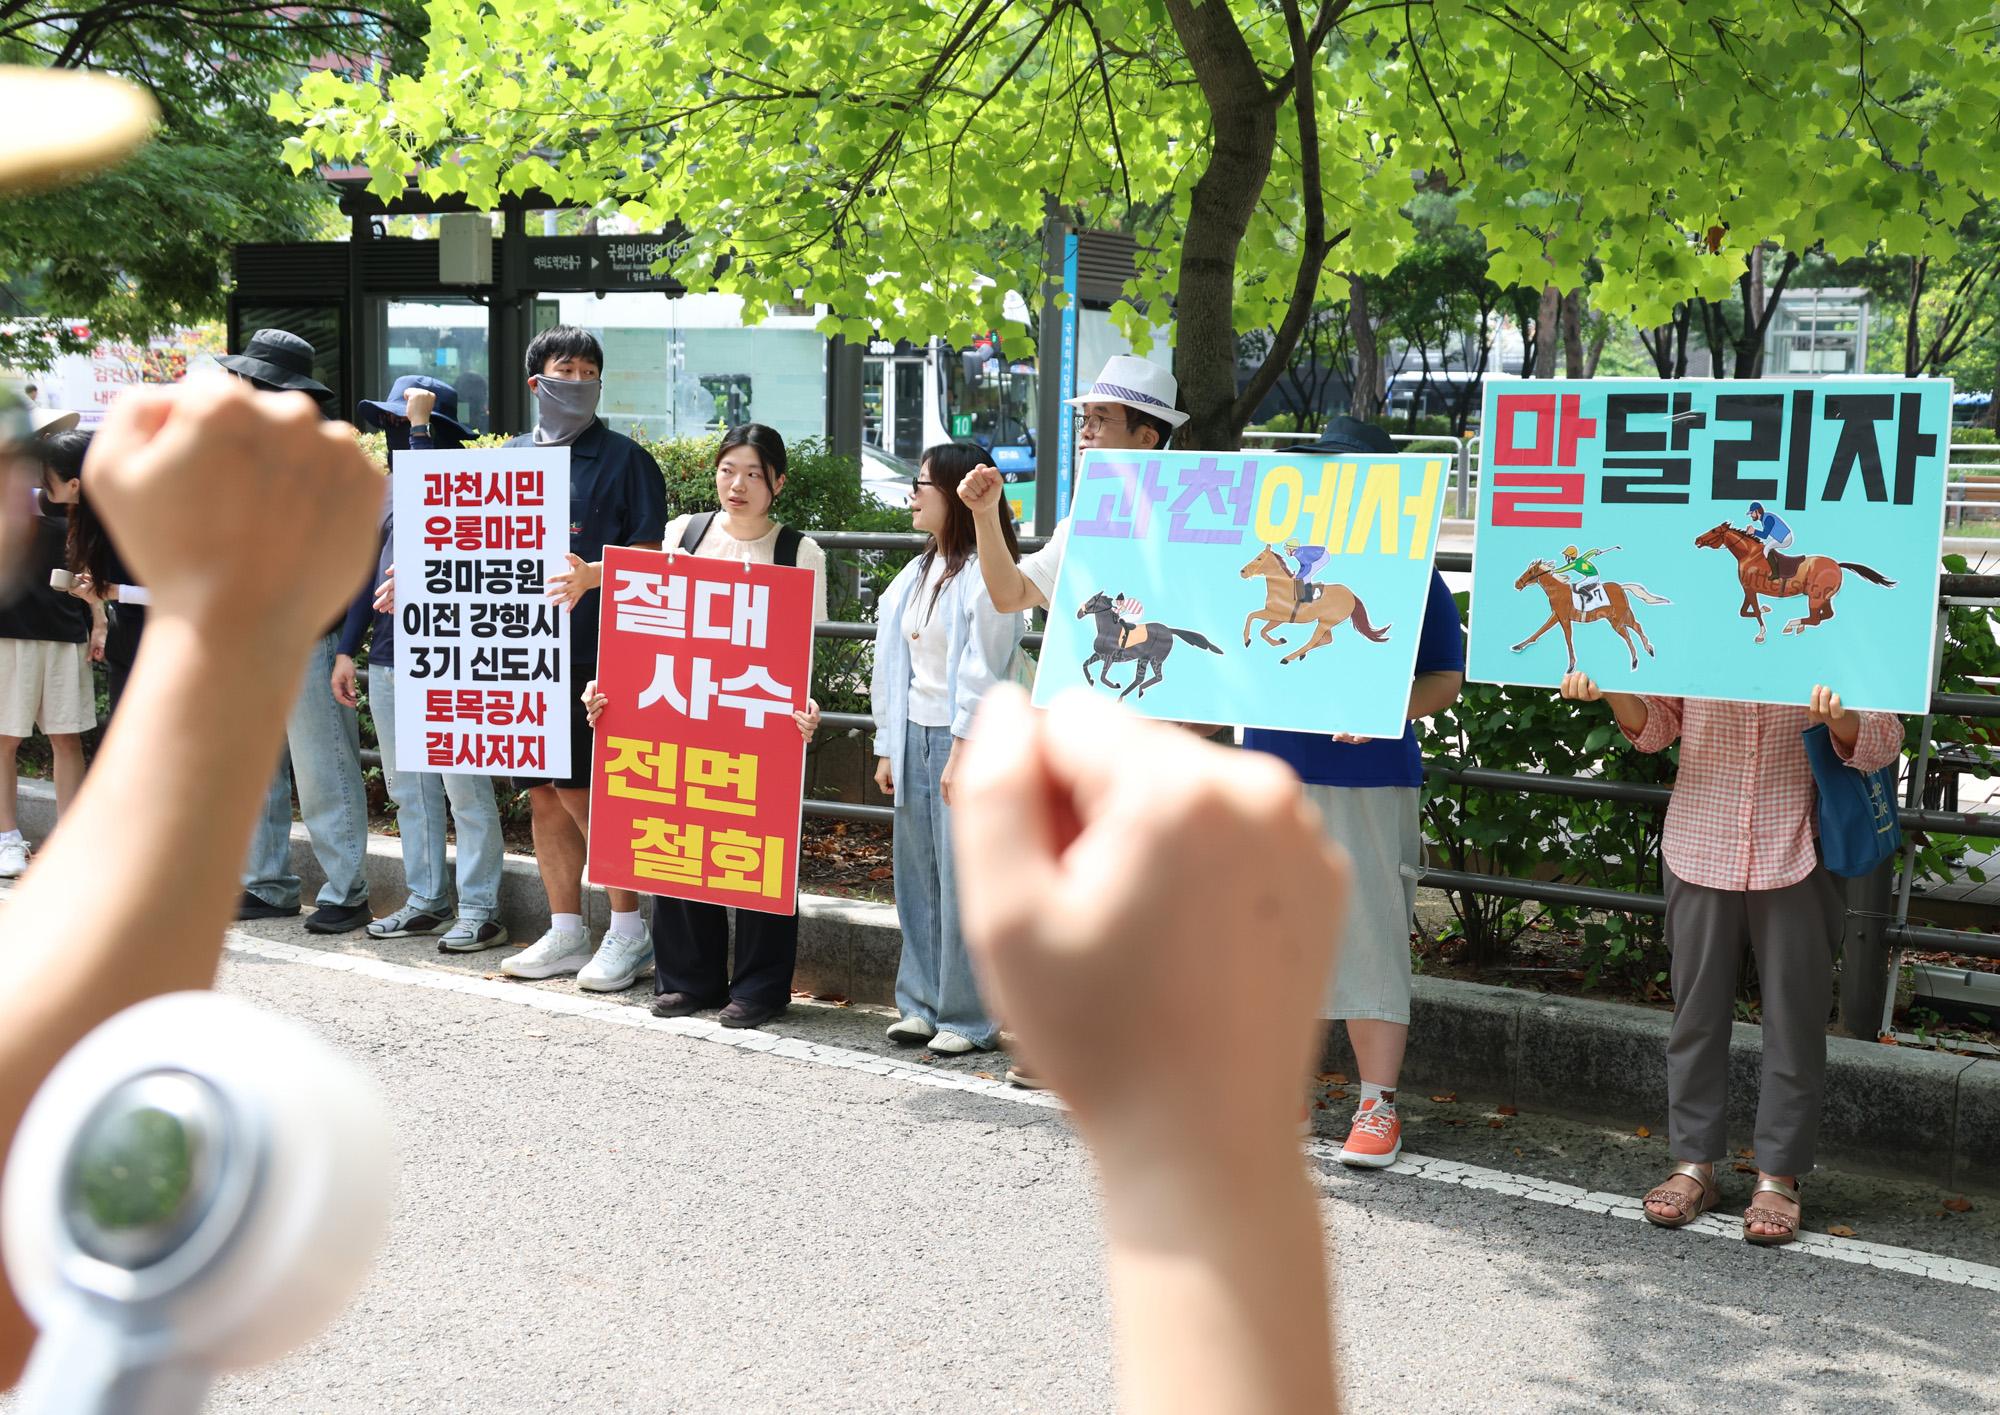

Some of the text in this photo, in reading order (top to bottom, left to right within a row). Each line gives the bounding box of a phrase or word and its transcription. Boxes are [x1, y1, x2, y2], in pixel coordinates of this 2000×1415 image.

[533, 255, 581, 271] 여의도역3번출구
[955, 418, 969, 434] 10
[1491, 389, 1938, 529] 말달리자
[423, 471, 544, 507] 과천시민
[1073, 457, 1443, 560] 과천에서
[424, 515, 546, 551] 우롱마라
[424, 559, 545, 594] 경마공원
[403, 602, 560, 639] 이전 강행시
[613, 569, 770, 650] 절대
[409, 646, 561, 683] 3기 신도시
[425, 689, 547, 727] 토목공사
[638, 653, 795, 730] 사수
[426, 732, 546, 771] 결사저지
[604, 735, 759, 817] 전면
[630, 816, 785, 899] 철회
